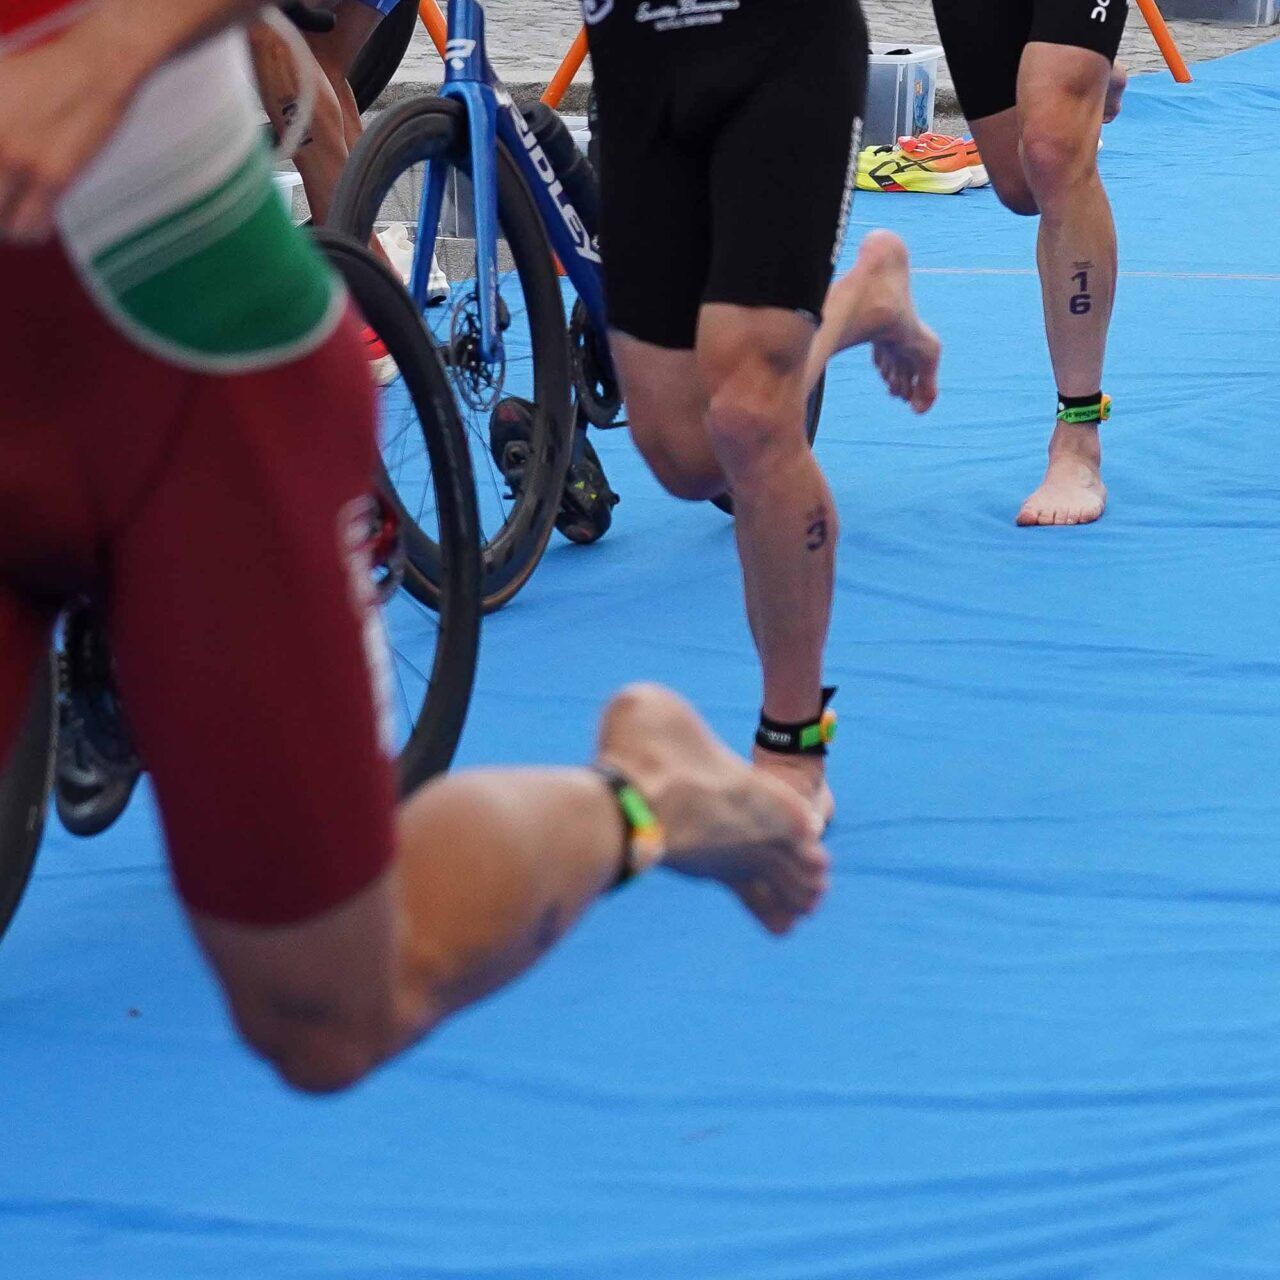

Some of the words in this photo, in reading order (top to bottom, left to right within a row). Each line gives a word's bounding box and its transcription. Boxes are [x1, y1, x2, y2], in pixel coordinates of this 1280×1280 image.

[509, 103, 604, 264] RIDLEY
[1069, 271, 1092, 315] 16
[806, 520, 826, 552] 3
